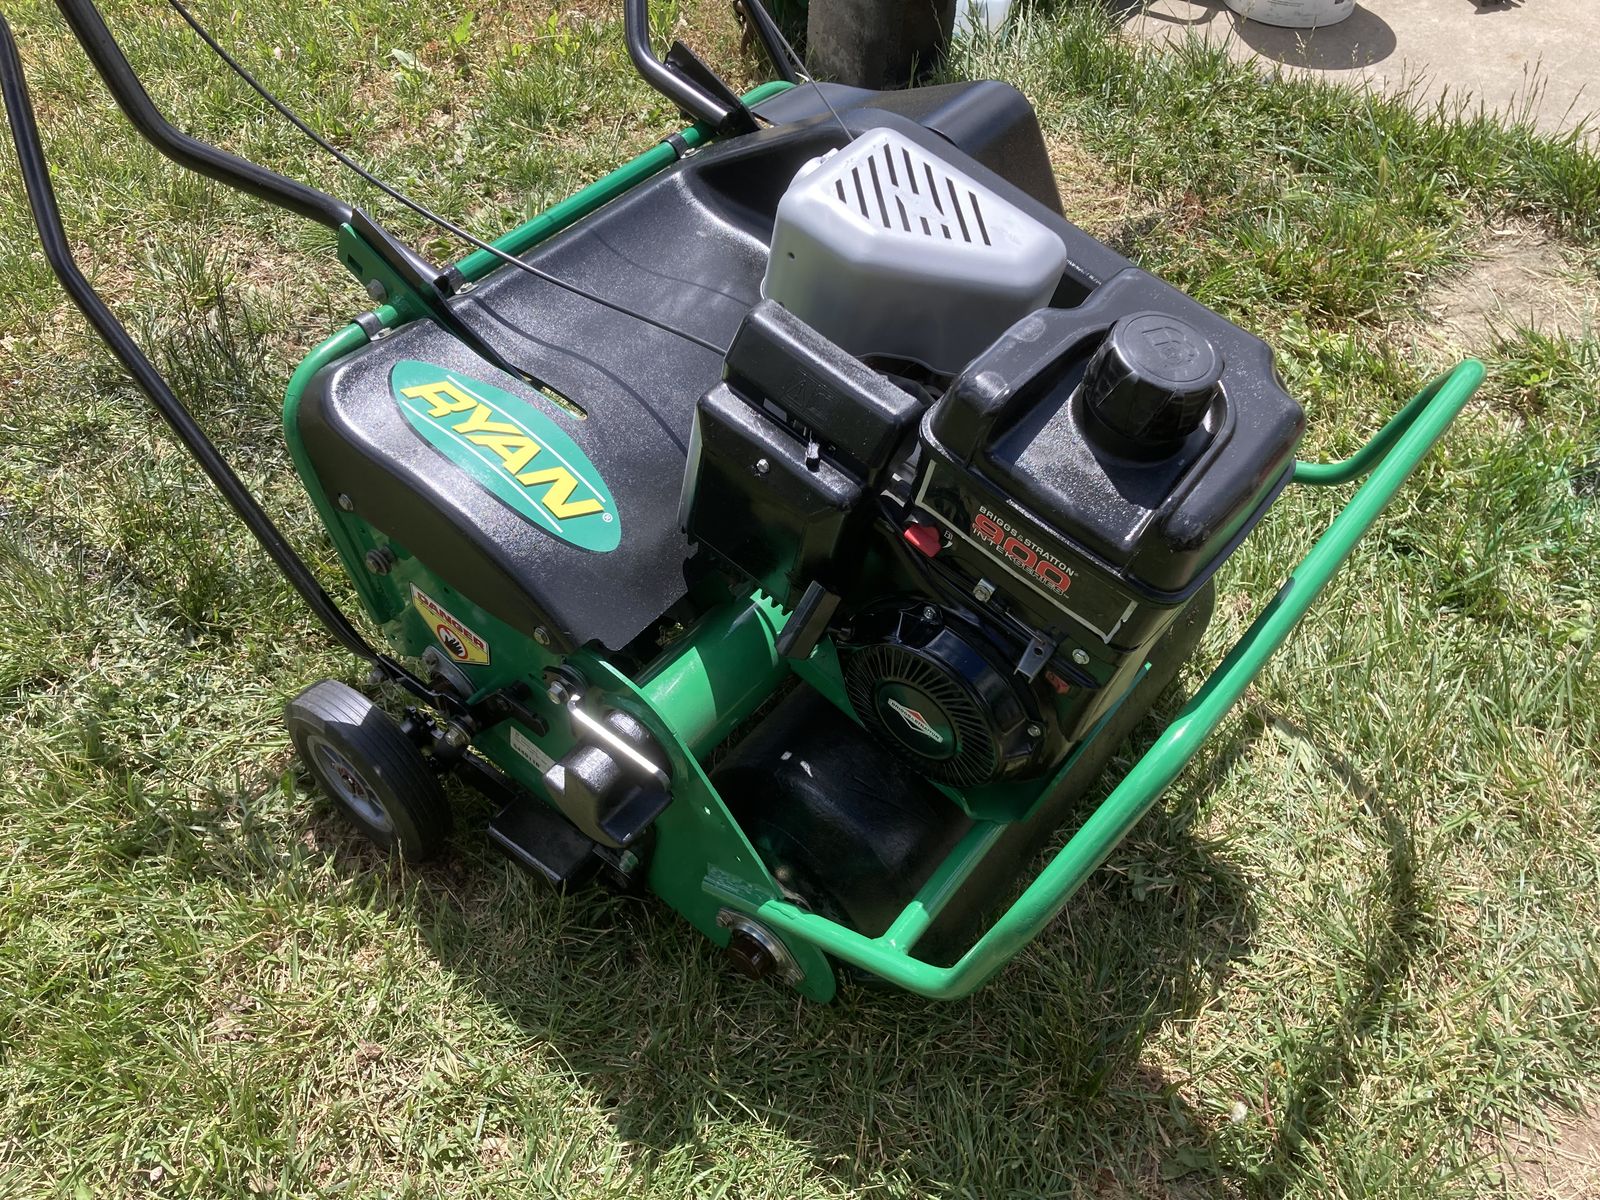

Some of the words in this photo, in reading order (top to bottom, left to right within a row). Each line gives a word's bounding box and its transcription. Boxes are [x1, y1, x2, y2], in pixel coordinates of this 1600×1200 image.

[400, 380, 606, 521] RYAN
[974, 513, 1072, 592] 900
[417, 592, 485, 650] DANGER
